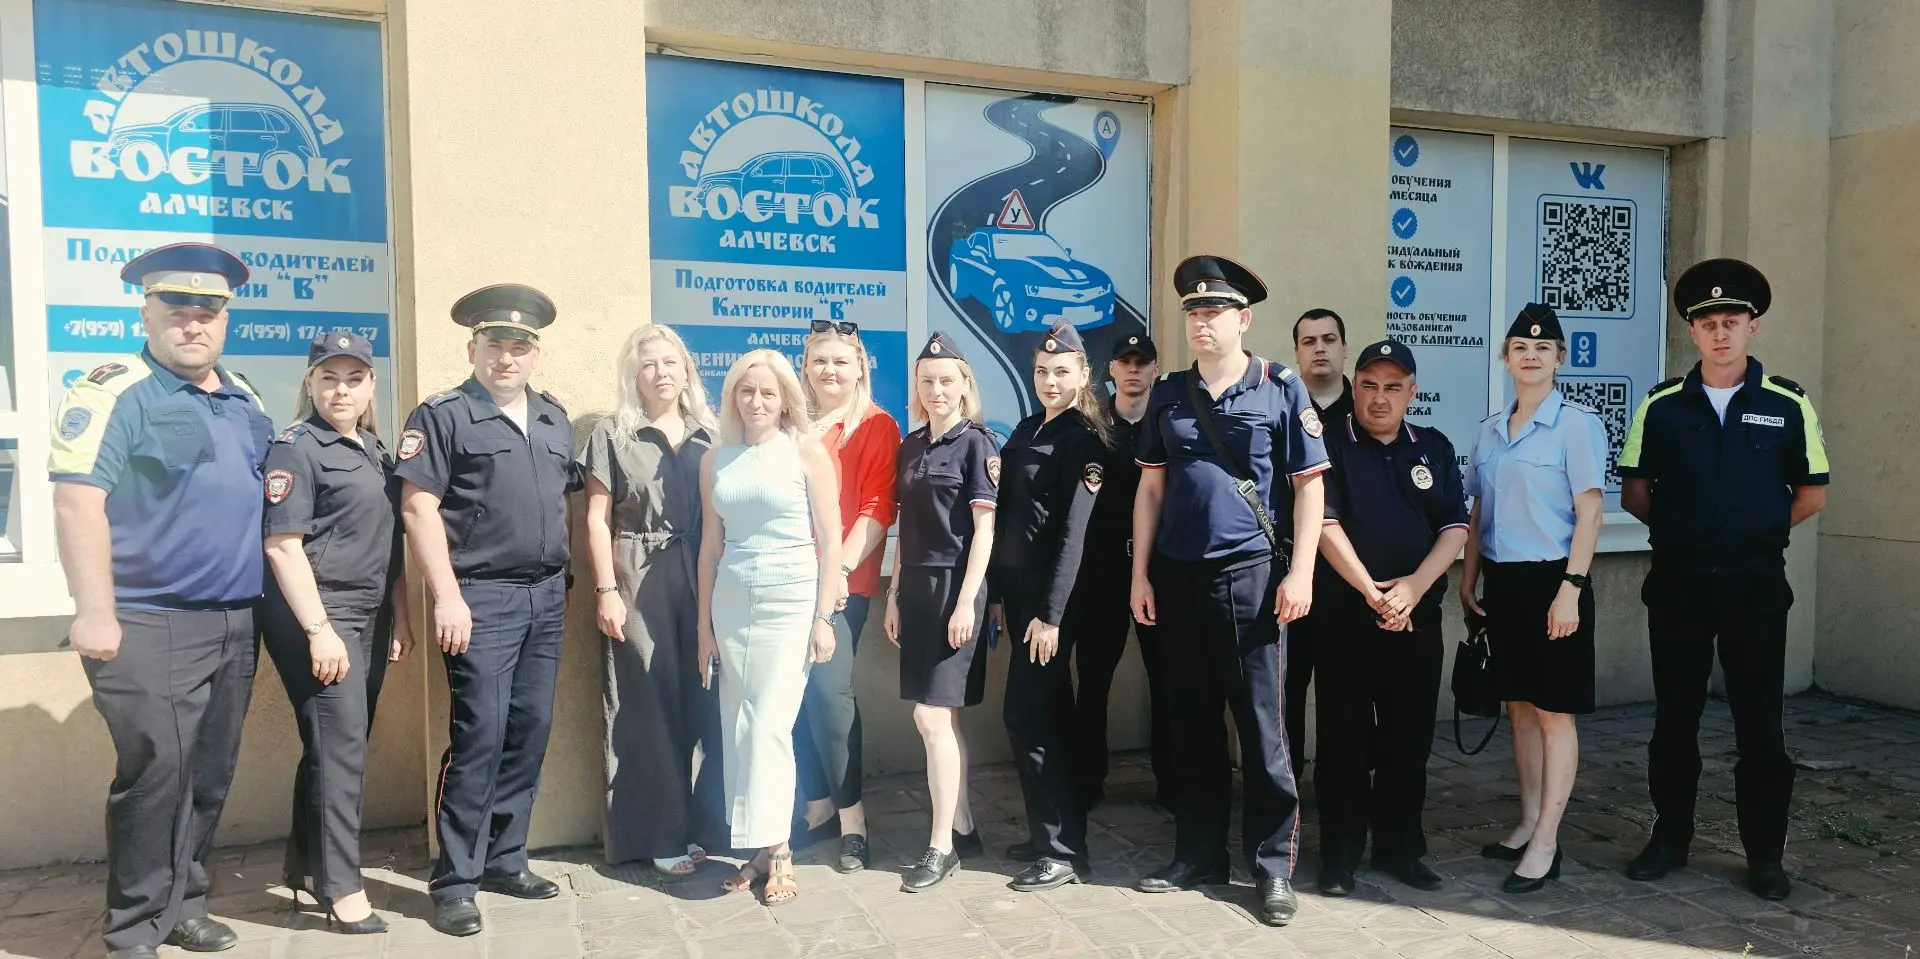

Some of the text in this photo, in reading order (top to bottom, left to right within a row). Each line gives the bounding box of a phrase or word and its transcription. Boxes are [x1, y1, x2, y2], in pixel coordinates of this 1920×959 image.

[83, 29, 344, 145] АВТОШКОЛА
[679, 89, 875, 187] АВТОШКОЛА
[70, 140, 352, 194] ВОСТОК
[1392, 175, 1451, 190] ОБУЧЕНИЯ
[140, 192, 293, 220] АЛЧЕВСК
[668, 185, 880, 229] ВОСТОК
[1389, 191, 1437, 203] МЕСЯЦА
[719, 229, 836, 253] АЛЧЕВСК
[1400, 260, 1463, 272] ВОЖДЕНИЯ
[1419, 313, 1467, 322] ОБУЧЕНИЯ
[1386, 334, 1483, 346] КОГО КАПИТАЛА
